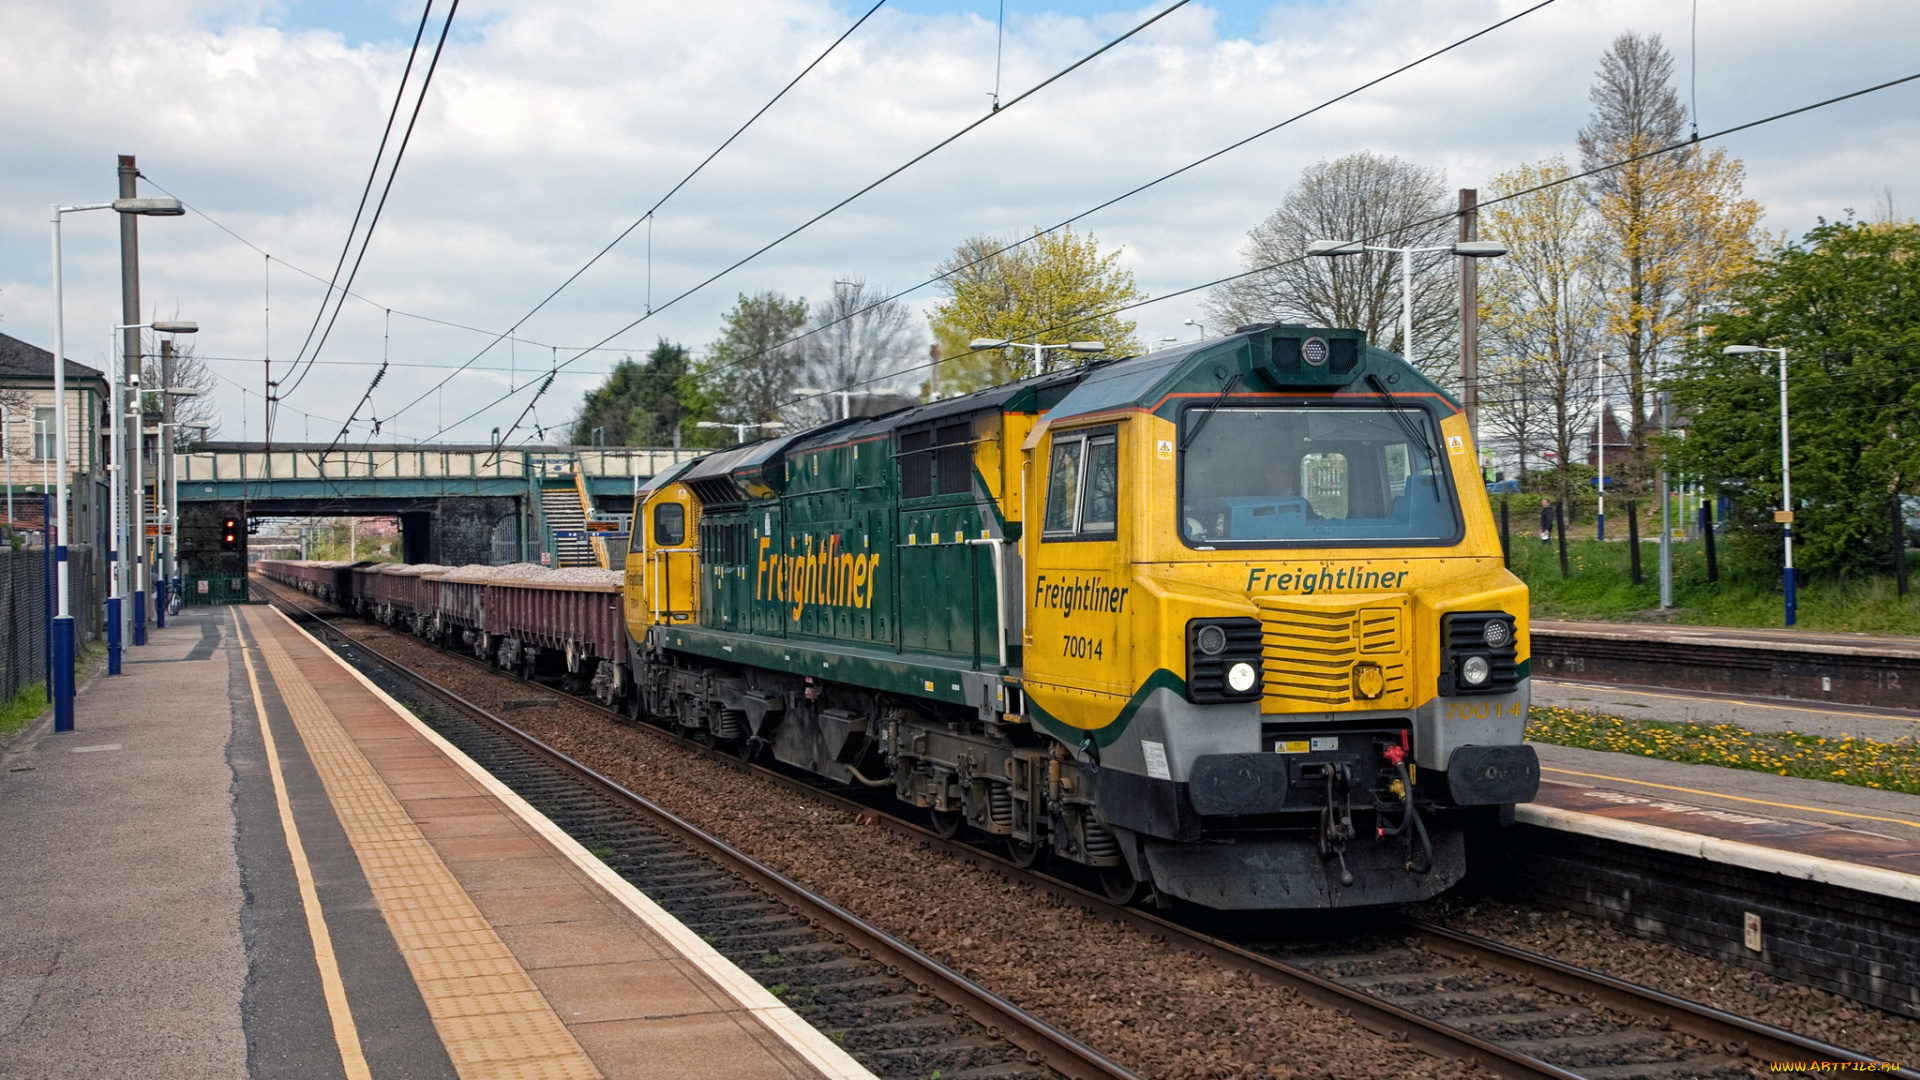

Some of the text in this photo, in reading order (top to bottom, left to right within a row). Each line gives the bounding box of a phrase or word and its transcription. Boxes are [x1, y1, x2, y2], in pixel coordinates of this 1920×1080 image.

[757, 534, 879, 621] Freightliner
[1247, 566, 1409, 595] Freightliner
[1034, 575, 1128, 618] Freightliner
[1063, 635, 1103, 661] 70014
[1446, 701, 1520, 720] 70014
